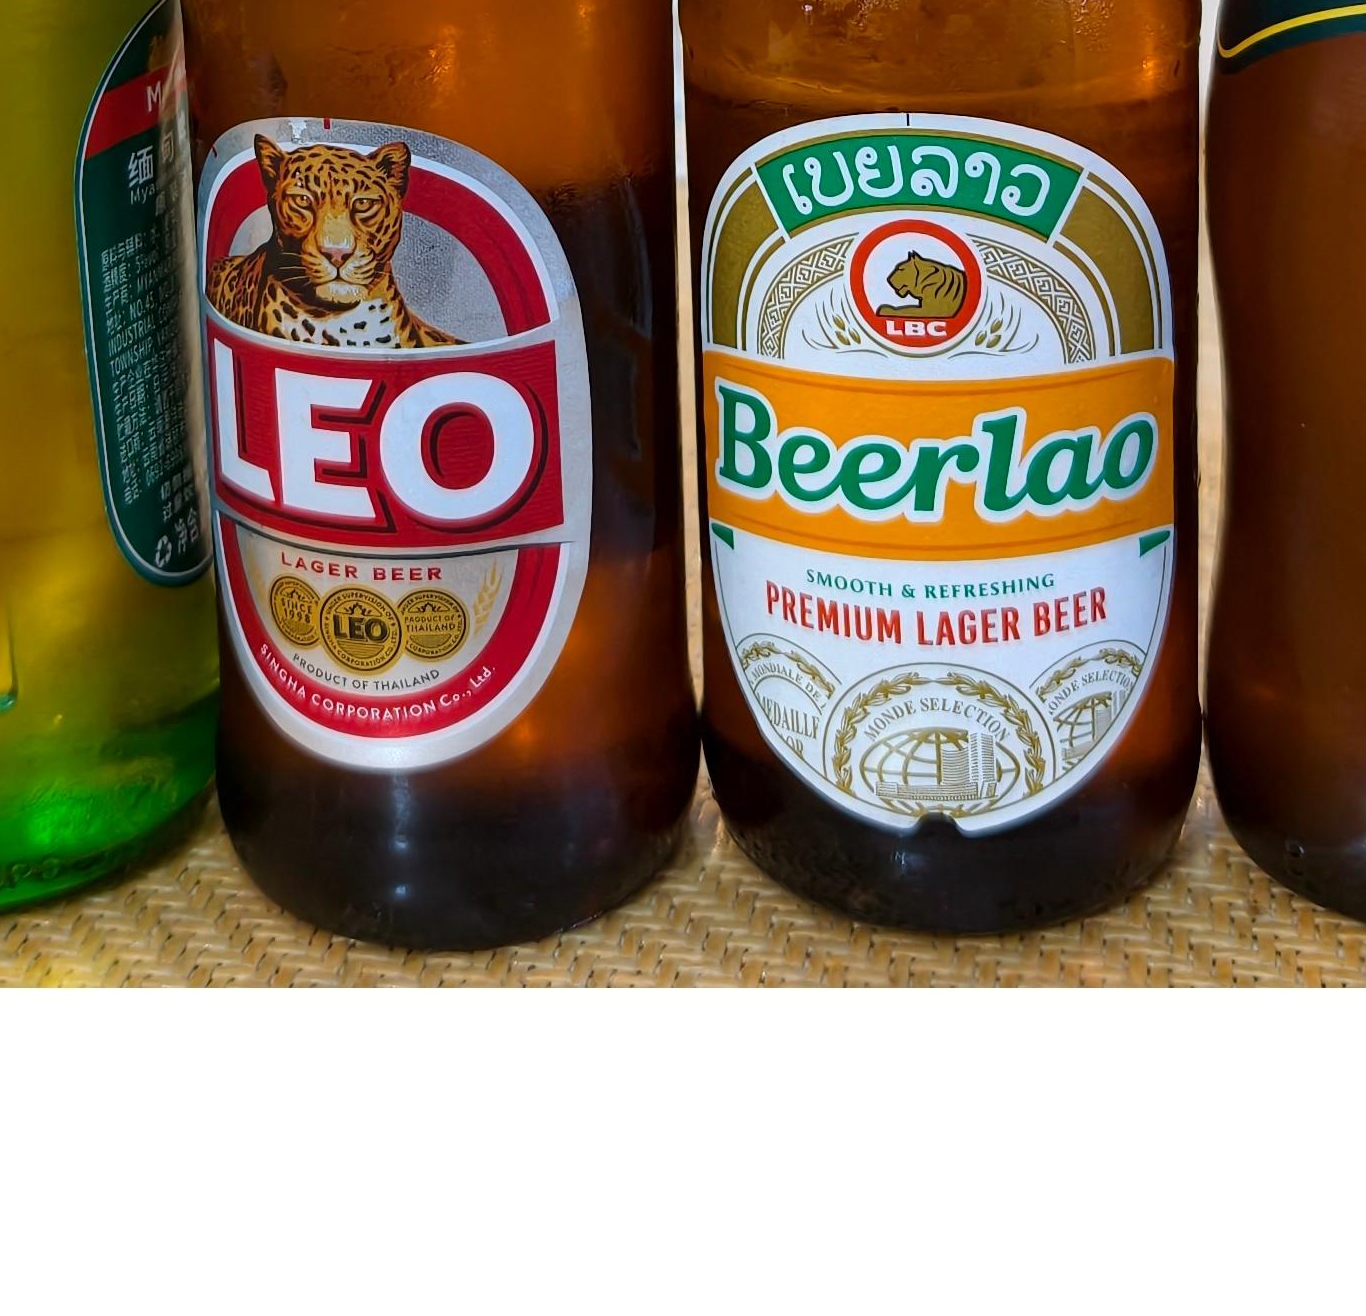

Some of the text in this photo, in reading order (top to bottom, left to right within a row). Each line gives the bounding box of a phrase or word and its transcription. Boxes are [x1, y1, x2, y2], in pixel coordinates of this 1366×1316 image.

[782, 145, 1051, 217] ເບຍລາວ
[885, 319, 948, 337] LBC
[212, 336, 536, 522] LEO
[716, 384, 1155, 517] Beerlao
[281, 550, 443, 581] LAGER BEER
[806, 567, 1056, 600] SMOOTH & REFRESHING
[280, 596, 314, 616] SINCE
[284, 607, 312, 625] 1998
[404, 613, 457, 625] PRODUCT OF
[765, 578, 1107, 647] PREMIUM LAGER BEER
[332, 614, 390, 643] LEO
[405, 622, 457, 633] THAILAND
[292, 652, 441, 691] PRODUCT OF THAILAND
[336, 648, 387, 668] CORPORATION
[260, 643, 307, 699] SINGHA
[311, 692, 437, 721] CORPORATION
[469, 664, 497, 689] Ltd.
[805, 682, 821, 700] DE
[1081, 669, 1135, 688] SELECTIO
[863, 696, 1011, 742] MONDE SELECTION
